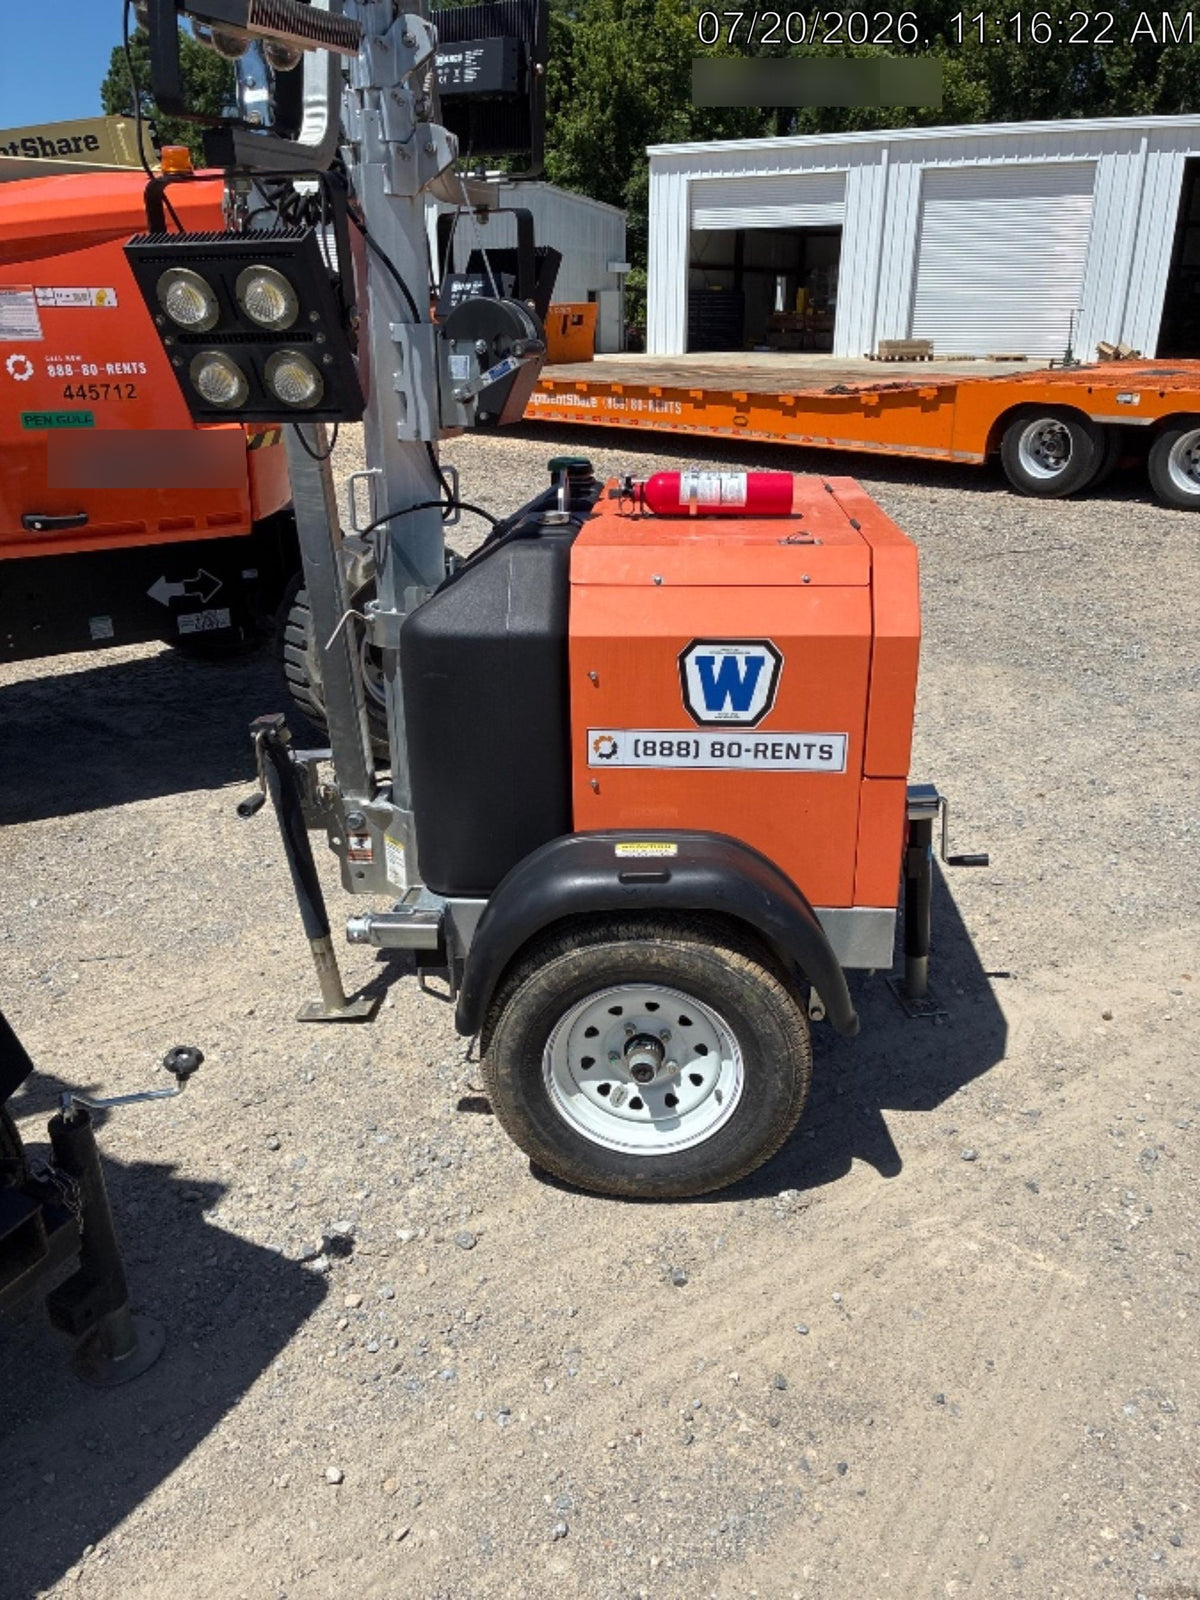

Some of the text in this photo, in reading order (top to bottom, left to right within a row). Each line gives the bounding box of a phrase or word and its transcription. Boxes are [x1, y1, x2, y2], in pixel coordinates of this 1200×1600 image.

[47, 362, 147, 378] 888-80-RENTS
[63, 383, 138, 401] 445712
[24, 415, 53, 425] PEN
[694, 655, 766, 712] W
[633, 738, 834, 761] (888) 80-RENTS
